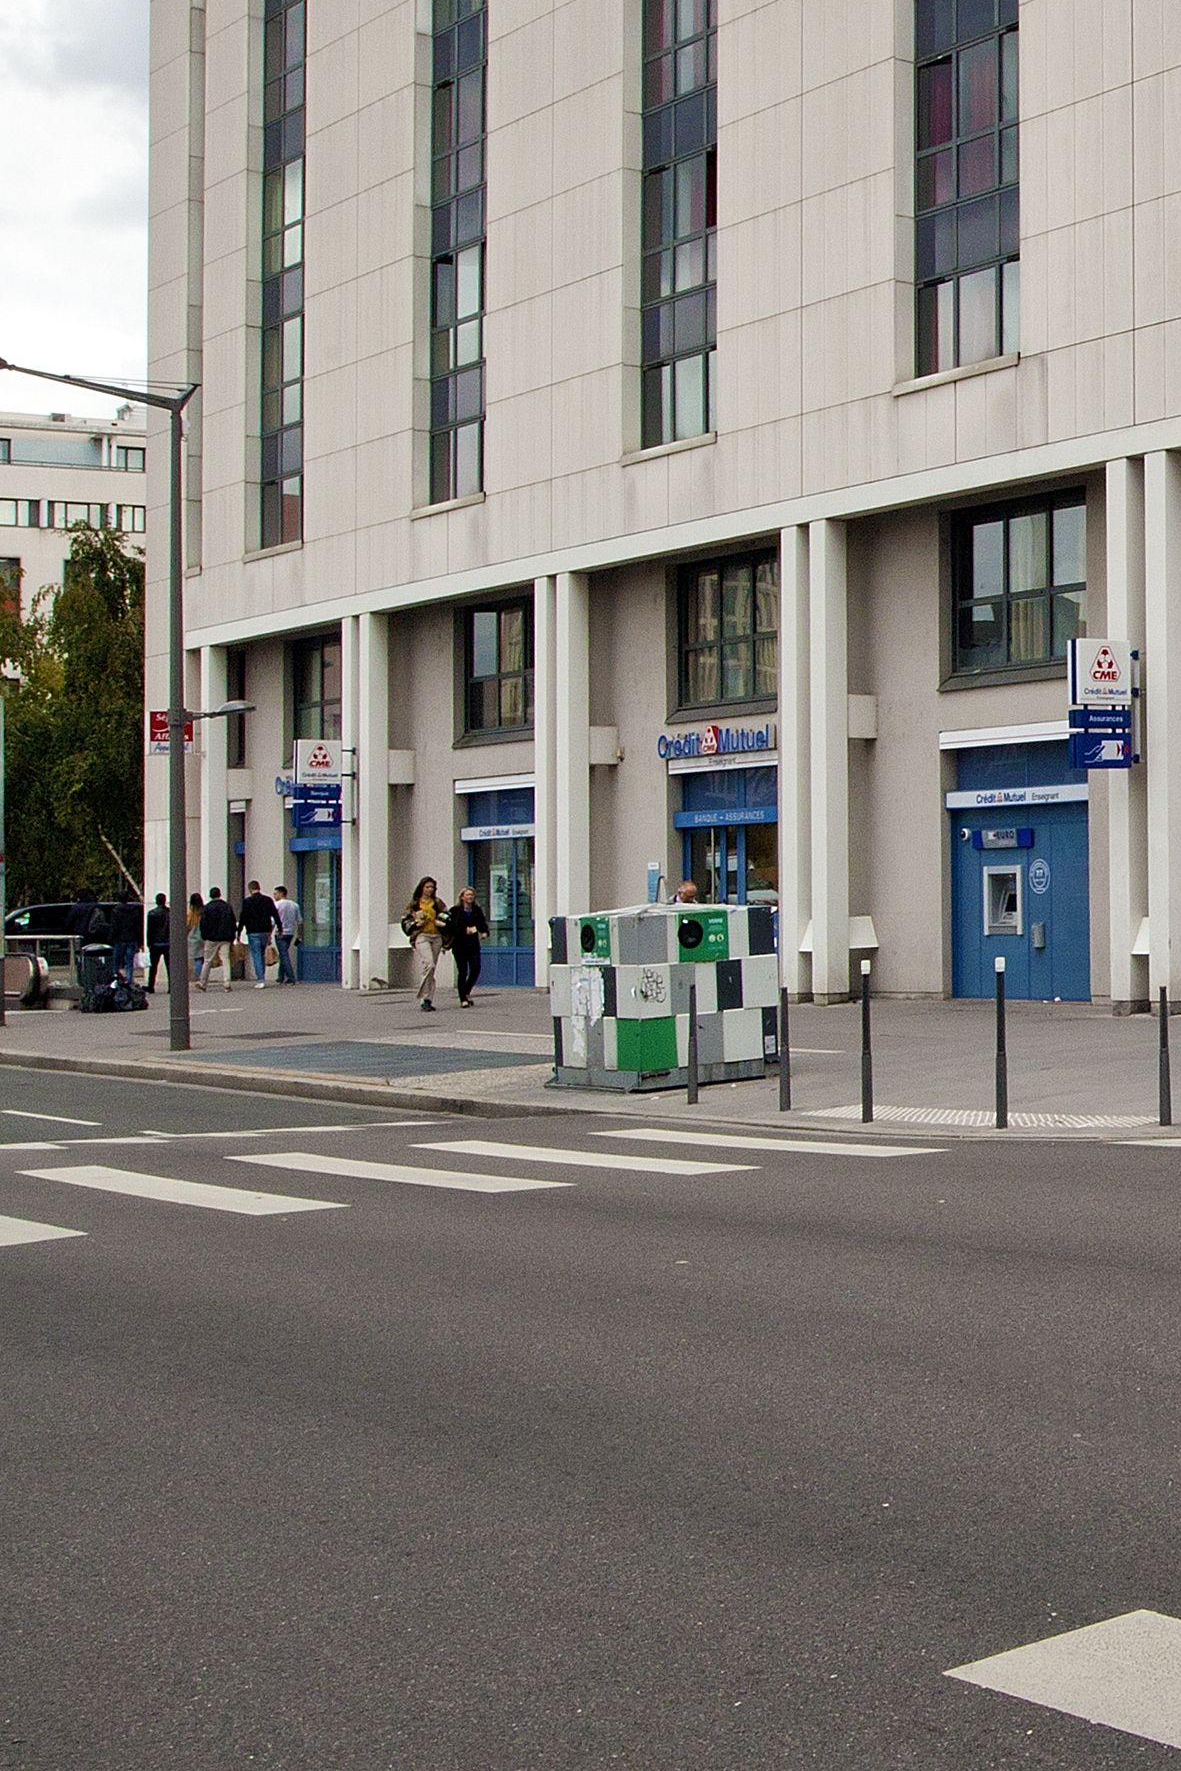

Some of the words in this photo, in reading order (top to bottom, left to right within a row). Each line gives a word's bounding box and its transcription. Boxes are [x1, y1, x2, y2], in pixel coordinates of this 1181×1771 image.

[1093, 671, 1117, 680] CME
[1089, 714, 1123, 723] Assurances
[658, 732, 700, 759] Crédit
[719, 724, 769, 752] Mutuel
[310, 760, 330, 768] CME
[1004, 791, 1027, 802] Mutuel
